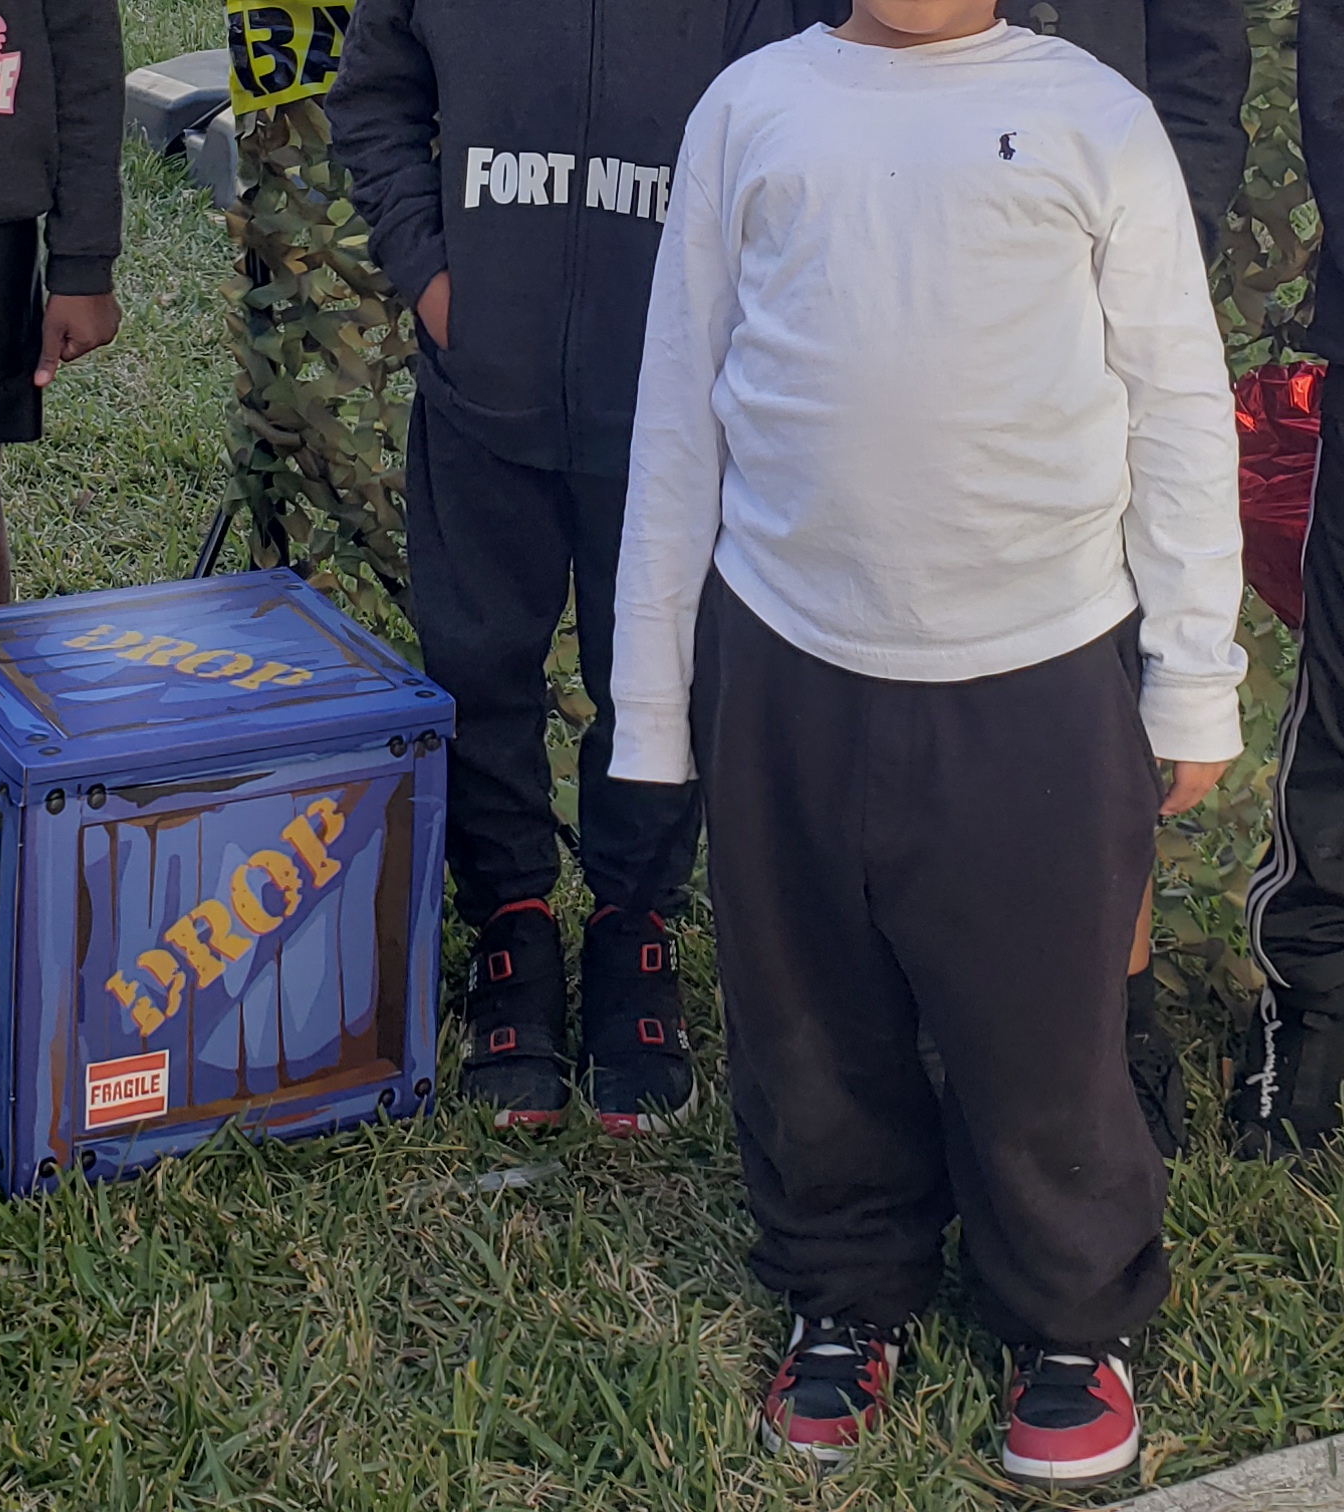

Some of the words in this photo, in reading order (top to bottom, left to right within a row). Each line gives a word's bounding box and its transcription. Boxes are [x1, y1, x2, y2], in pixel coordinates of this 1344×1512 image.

[62, 624, 314, 690] DROP
[105, 797, 346, 1038] DROP
[91, 1073, 160, 1105] FRAGILE
